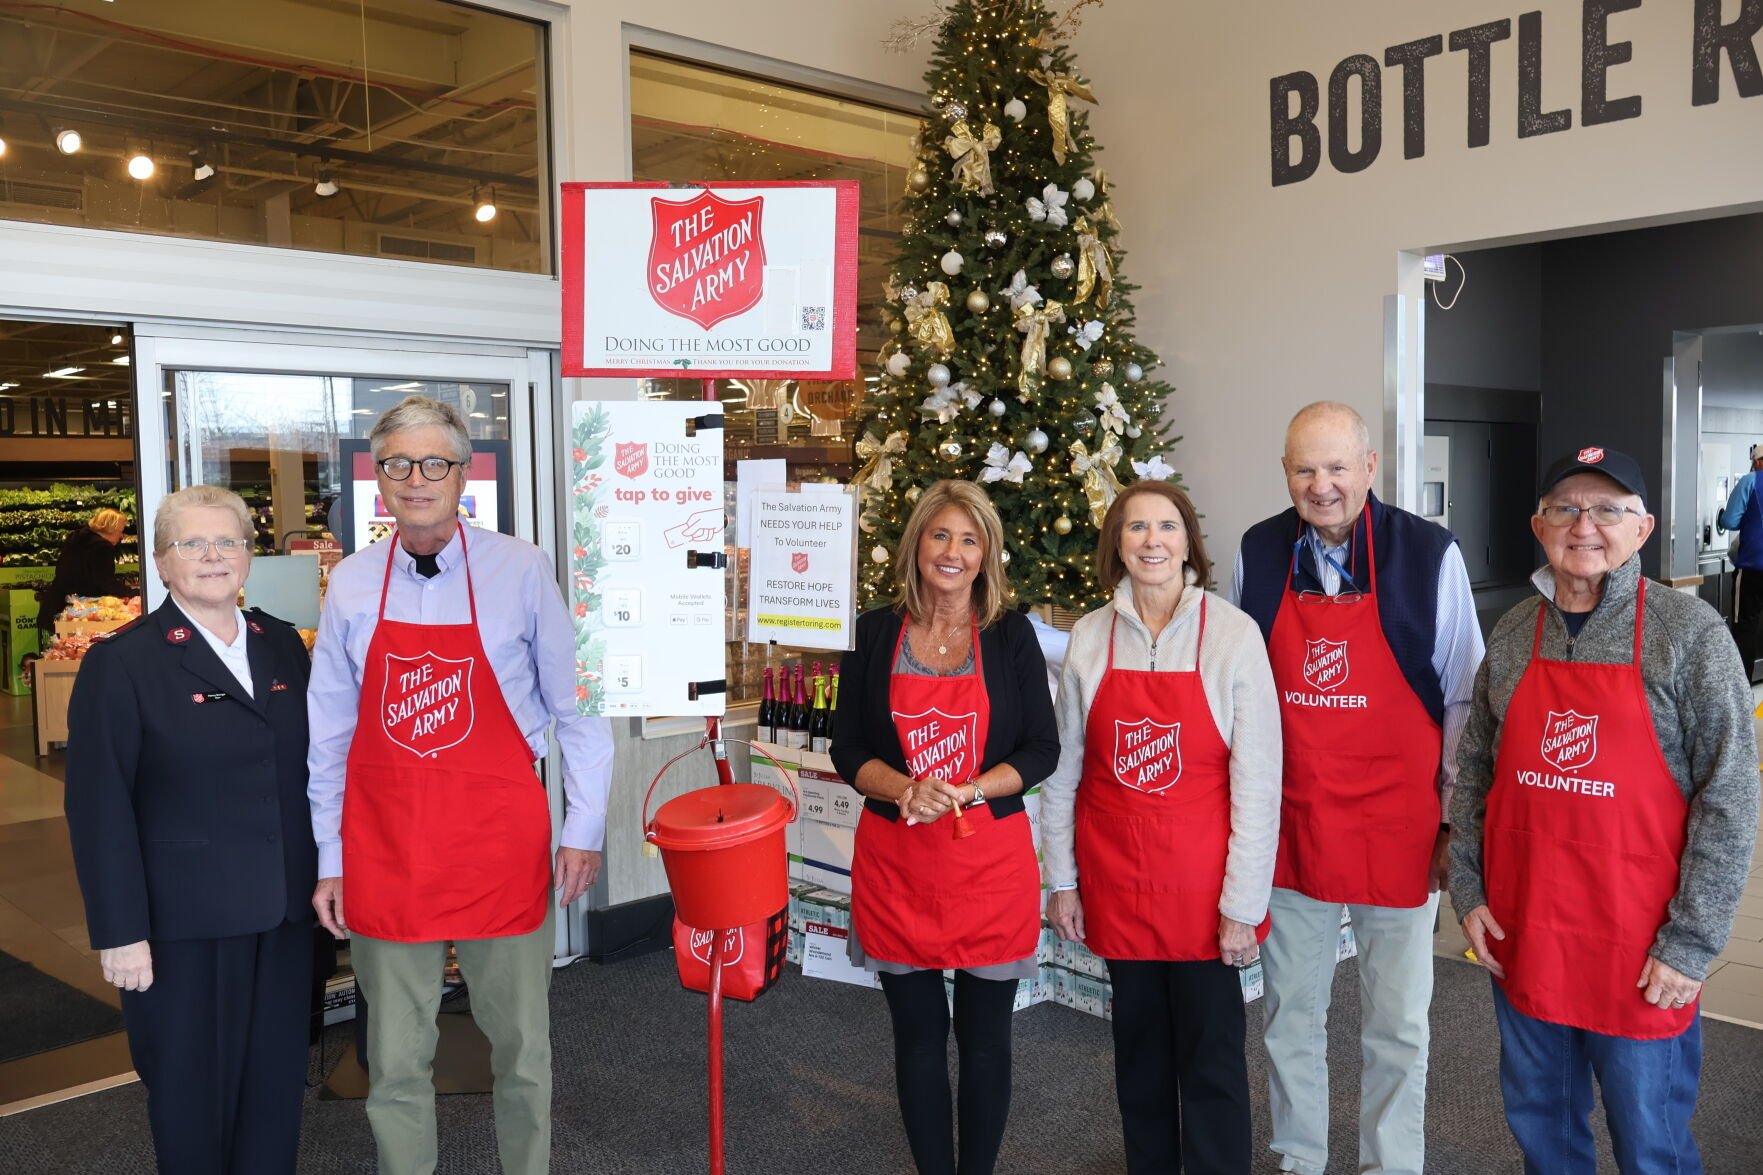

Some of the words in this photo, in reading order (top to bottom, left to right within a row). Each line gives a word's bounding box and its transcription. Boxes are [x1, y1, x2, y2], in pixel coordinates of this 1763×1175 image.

[1270, 0, 1641, 187] BOTTLE
[670, 205, 715, 248] THE
[656, 211, 752, 294] SALVATION
[691, 250, 749, 312] ARMY
[605, 336, 664, 352] DOING
[669, 338, 701, 352] THE
[706, 338, 754, 352] MOST
[757, 338, 811, 352] GOOD
[655, 442, 700, 454] DOING
[653, 455, 679, 466] THE
[683, 455, 720, 466] MOST
[653, 468, 696, 478] GOOD
[615, 487, 645, 504] tap
[651, 488, 670, 501] to
[675, 486, 713, 505] give
[761, 502, 777, 511] The
[778, 502, 818, 513] Salvation
[819, 504, 842, 515] Army
[760, 519, 790, 529] NEEDS
[792, 520, 817, 530] YOUR
[819, 521, 843, 531] HELP
[312, 540, 333, 550] Sale
[774, 537, 784, 546] To
[786, 538, 827, 548] Volunteer
[16, 573, 55, 581] PISTACHIO
[766, 580, 806, 590] RESTORE
[808, 582, 833, 592] HOPE
[760, 595, 813, 606] TRANSFORM
[815, 599, 840, 609] LIVES
[757, 617, 842, 630] www.registertoring.com
[173, 629, 185, 640] S
[1311, 643, 1327, 659] THE
[1305, 645, 1343, 676] SALVATION
[399, 663, 433, 694] THE
[1316, 660, 1342, 685] ARMY
[387, 669, 462, 727] SALVATION
[1284, 690, 1367, 708] VOLUNTEER
[411, 698, 459, 741] ARMY
[1554, 715, 1575, 733] THE
[907, 720, 941, 751] THE
[1125, 724, 1152, 749] THE
[1544, 720, 1593, 753] SALVATION
[905, 724, 967, 780] SALVATION
[1118, 729, 1175, 774] SALVATION
[1556, 738, 1590, 763] ARMY
[800, 770, 818, 779] SALE
[1136, 752, 1173, 786] ARMY
[1516, 770, 1615, 797] VOLUNTEER
[808, 804, 824, 814] 4.99
[834, 799, 850, 809] 4.49
[808, 925, 829, 935] SALE
